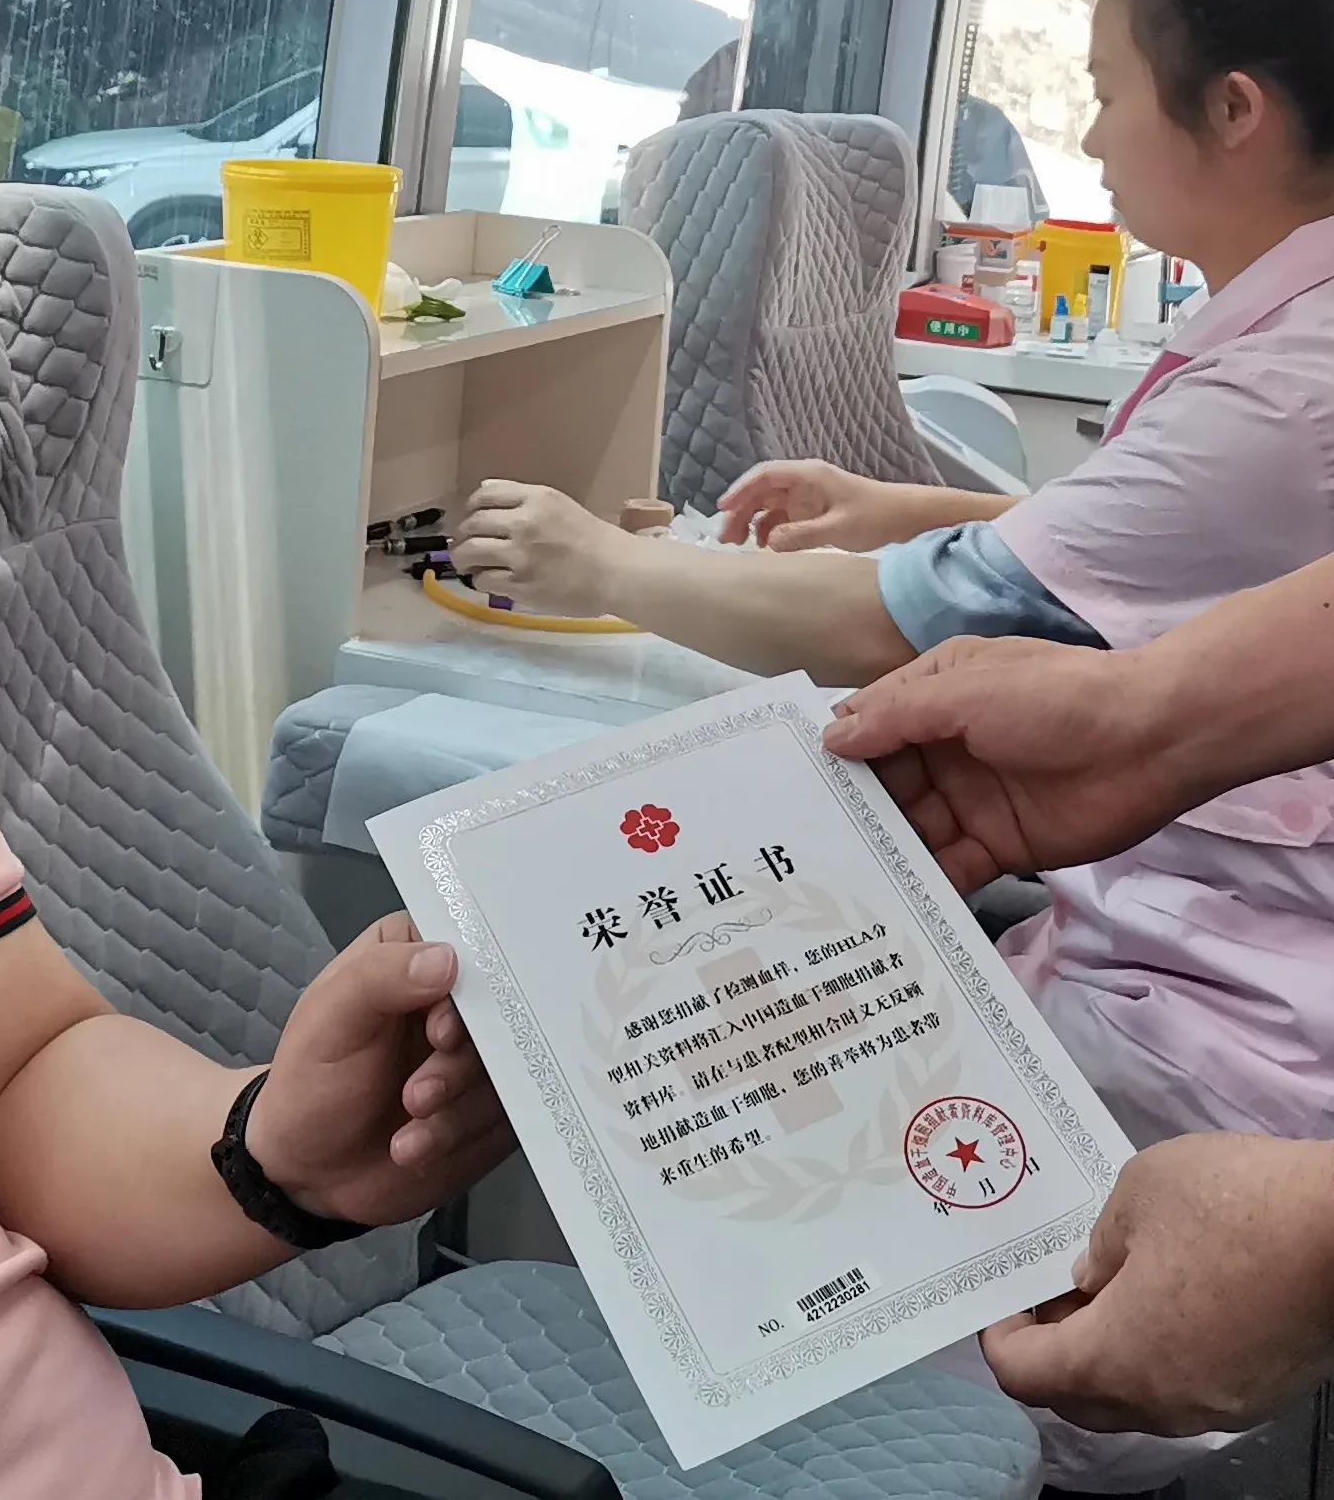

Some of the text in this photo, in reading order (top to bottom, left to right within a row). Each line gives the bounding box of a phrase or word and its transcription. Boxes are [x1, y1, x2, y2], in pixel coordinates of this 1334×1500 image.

[577, 845, 795, 951] 荣誉证书
[979, 1177, 996, 1198] 月
[1025, 1156, 1041, 1176] 日
[757, 1280, 871, 1338] NO. 4212230281
